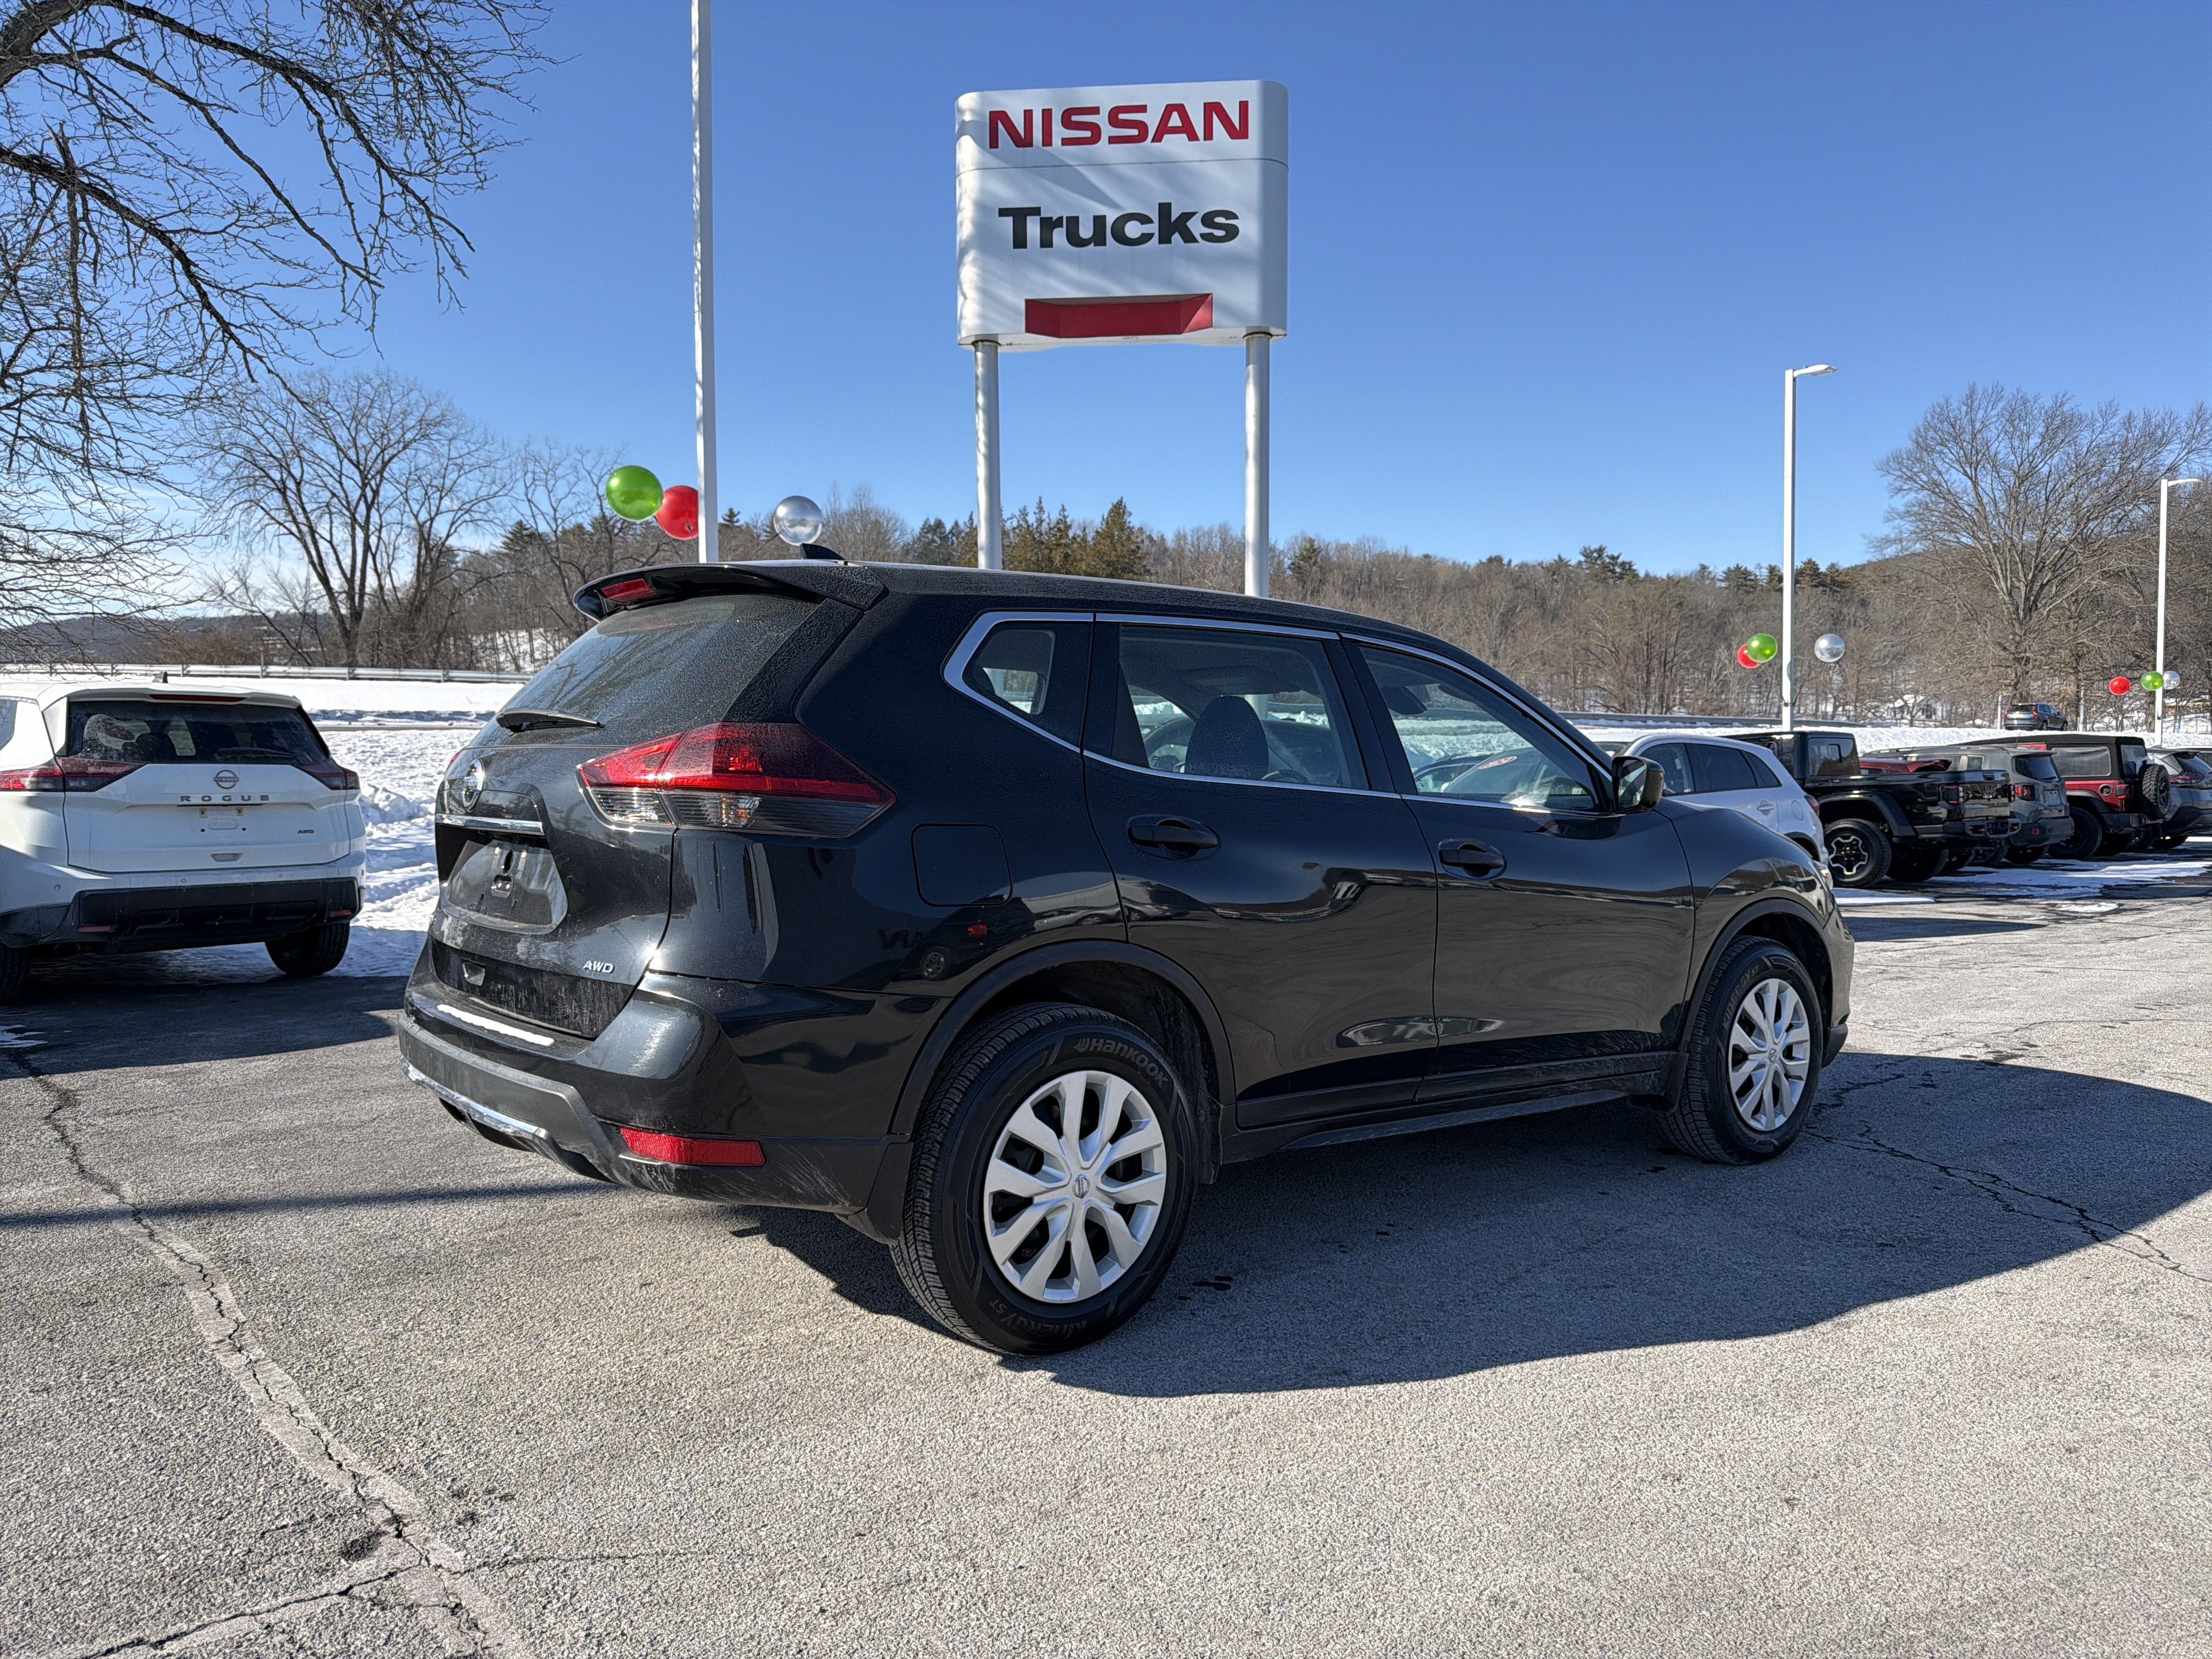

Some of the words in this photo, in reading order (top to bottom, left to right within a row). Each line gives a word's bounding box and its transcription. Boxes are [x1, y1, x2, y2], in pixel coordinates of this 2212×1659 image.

[989, 100, 1249, 149] NISSAN
[998, 202, 1240, 249] Trucks
[583, 960, 615, 974] AWD
